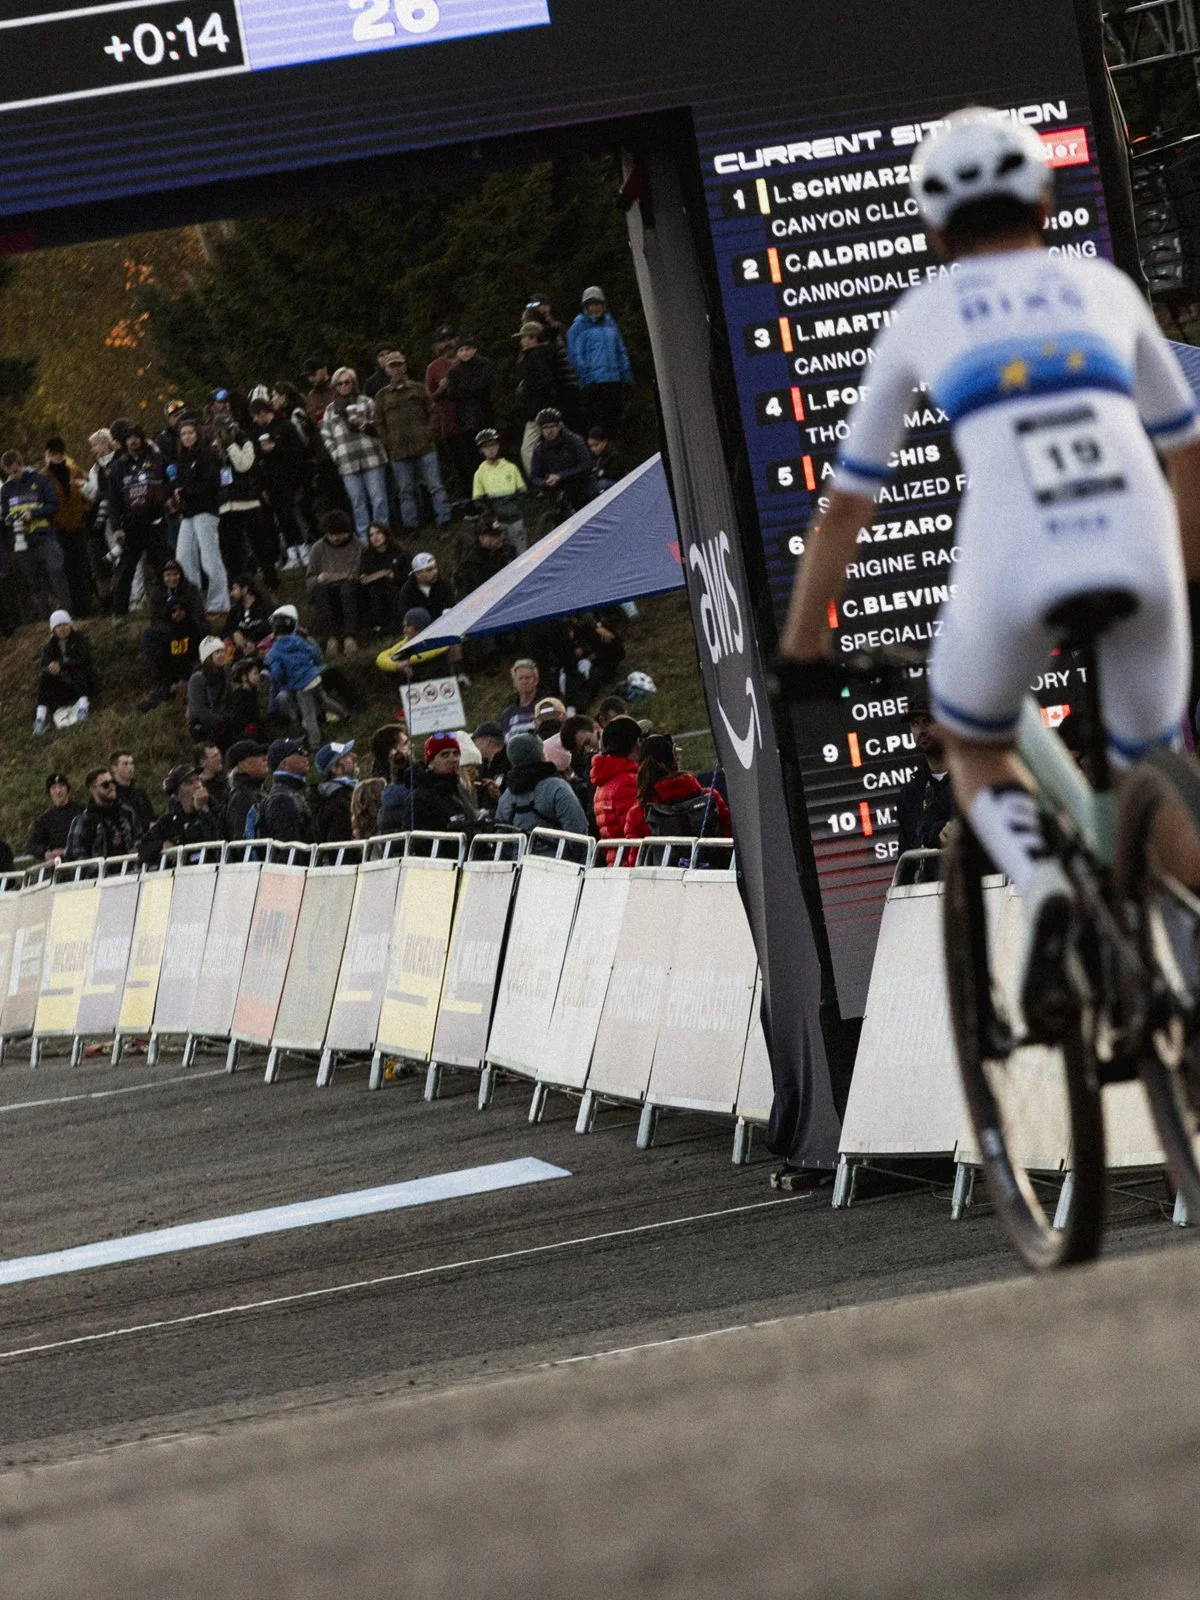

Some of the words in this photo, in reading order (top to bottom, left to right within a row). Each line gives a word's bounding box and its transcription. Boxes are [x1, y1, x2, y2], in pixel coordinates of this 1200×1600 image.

[103, 12, 230, 66] +0:14
[350, 0, 441, 42] 26
[714, 129, 882, 175] CURRENT
[890, 100, 1067, 147] SITION
[733, 188, 746, 210] 1
[773, 164, 924, 204] L.SCHWARZ
[771, 208, 861, 237] CANYON
[866, 197, 924, 222] CLLC
[742, 259, 760, 280] 2
[785, 233, 928, 272] C.ALDRIDGE
[783, 267, 921, 307] CANNONDALE
[754, 328, 771, 348] 3
[794, 347, 882, 375] CANNON
[765, 397, 782, 416] 4
[805, 419, 851, 444] THÖ
[904, 407, 950, 428] MAX
[777, 466, 794, 486] 5
[788, 535, 805, 555] 6
[856, 514, 952, 544] AZZARO
[845, 553, 917, 579] RIGINE
[922, 546, 965, 568] RAC
[689, 530, 743, 664] aws
[840, 620, 944, 652] SPECIALIZ
[852, 696, 909, 721] ORBE
[822, 743, 839, 763] 9
[827, 812, 857, 833] 10
